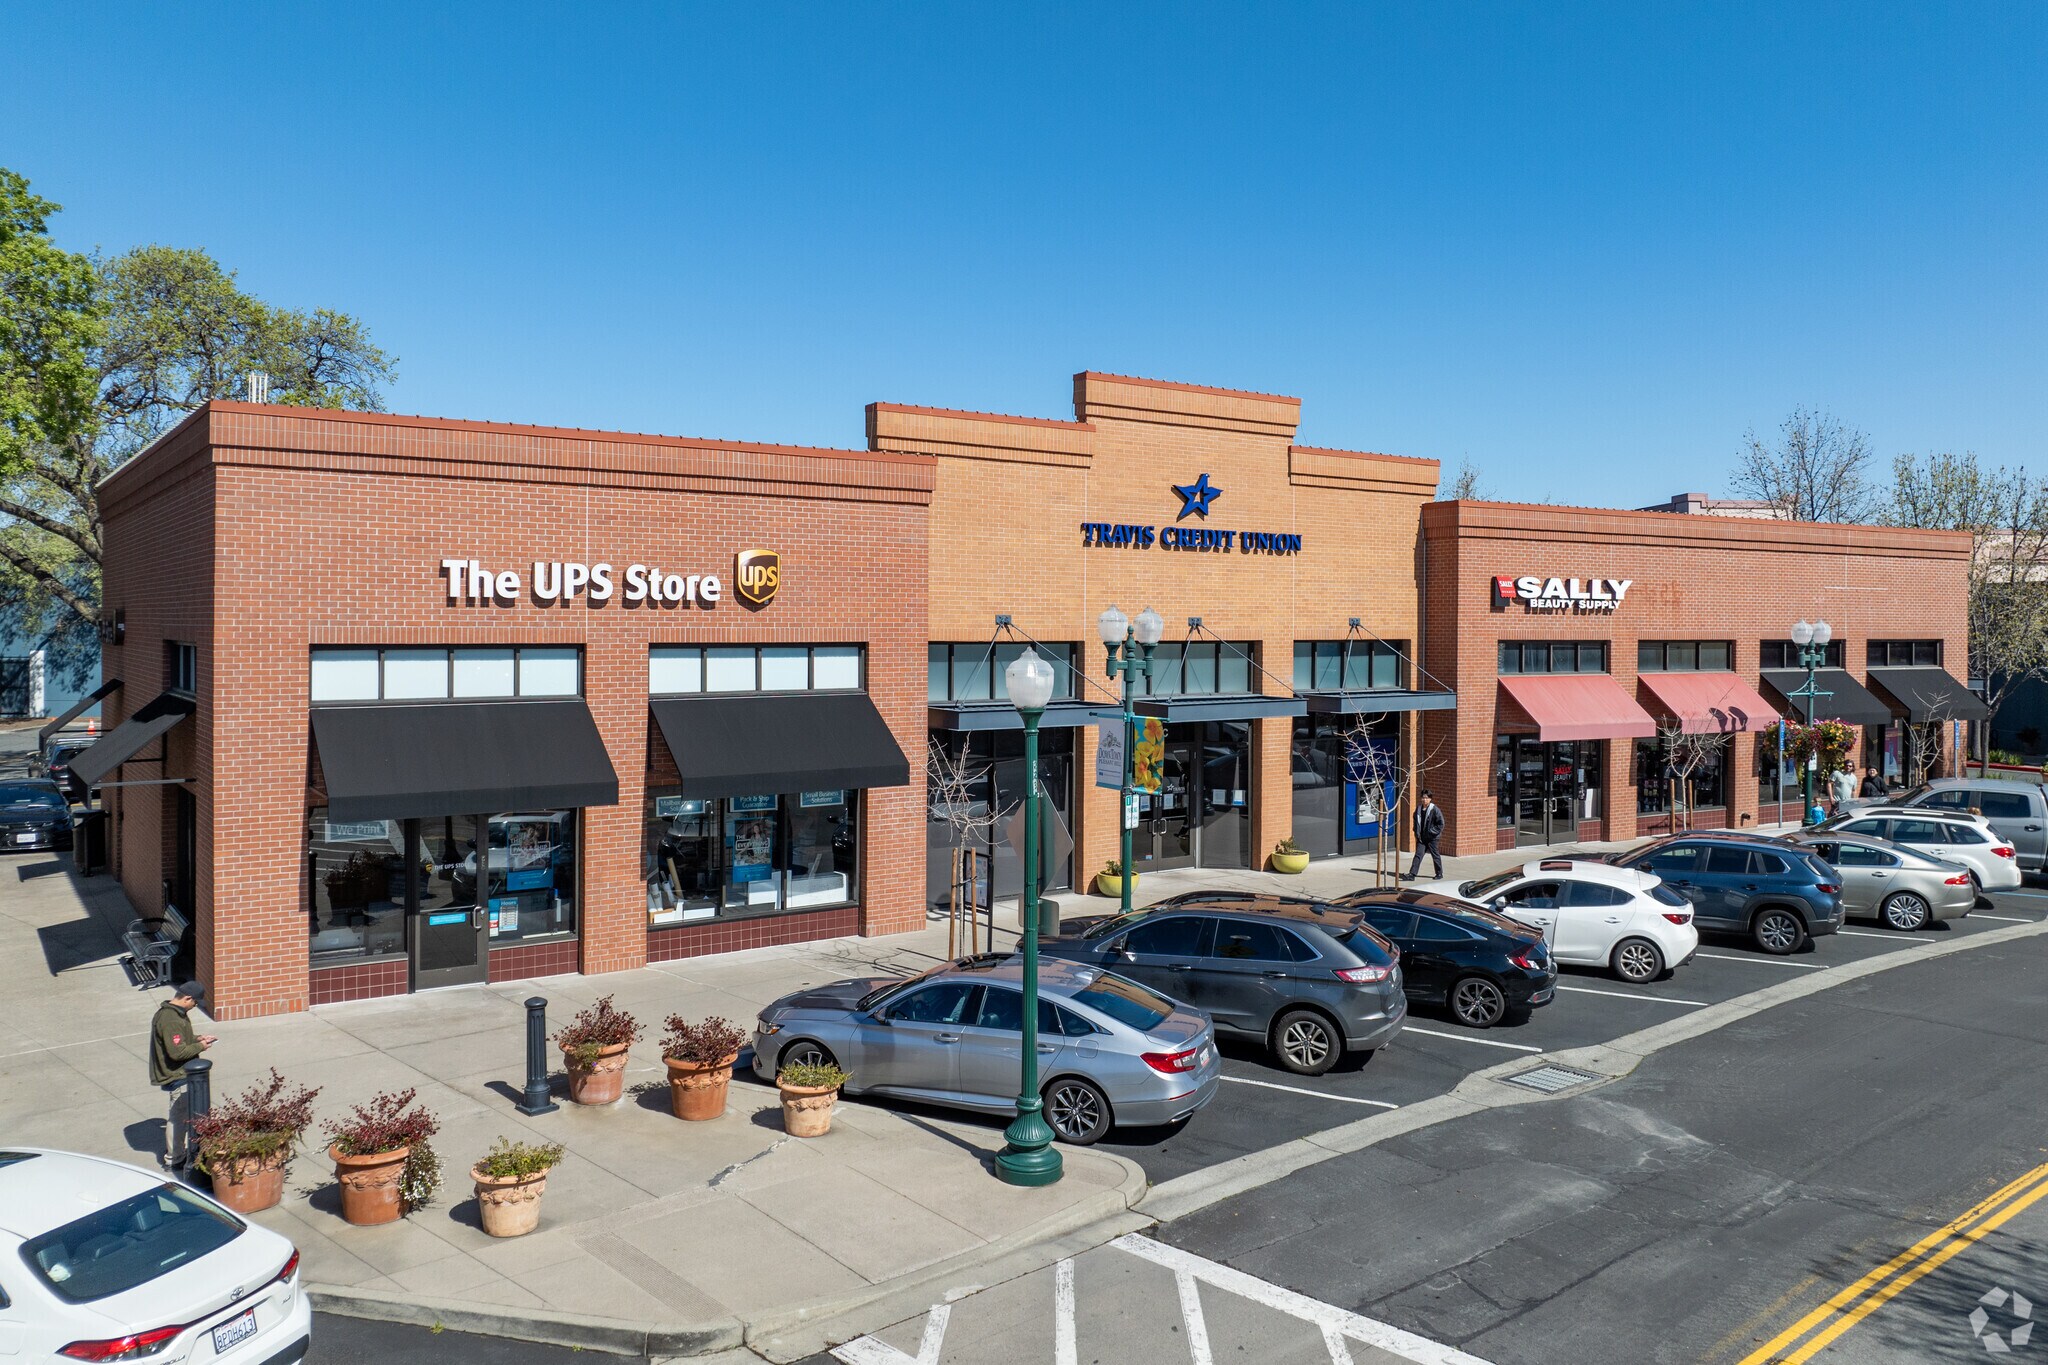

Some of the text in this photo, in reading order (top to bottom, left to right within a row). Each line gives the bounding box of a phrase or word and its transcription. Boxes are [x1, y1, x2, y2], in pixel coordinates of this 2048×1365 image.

[1082, 523, 1302, 552] TRAVIS CREDIT UNION
[442, 559, 721, 601] The UPS Store
[741, 565, 777, 595] ups
[1517, 576, 1633, 600] SALLY
[1530, 599, 1621, 609] BEAUTY SUPPLY
[336, 823, 381, 836] We Print
[217, 1318, 254, 1349] 8PDH613
